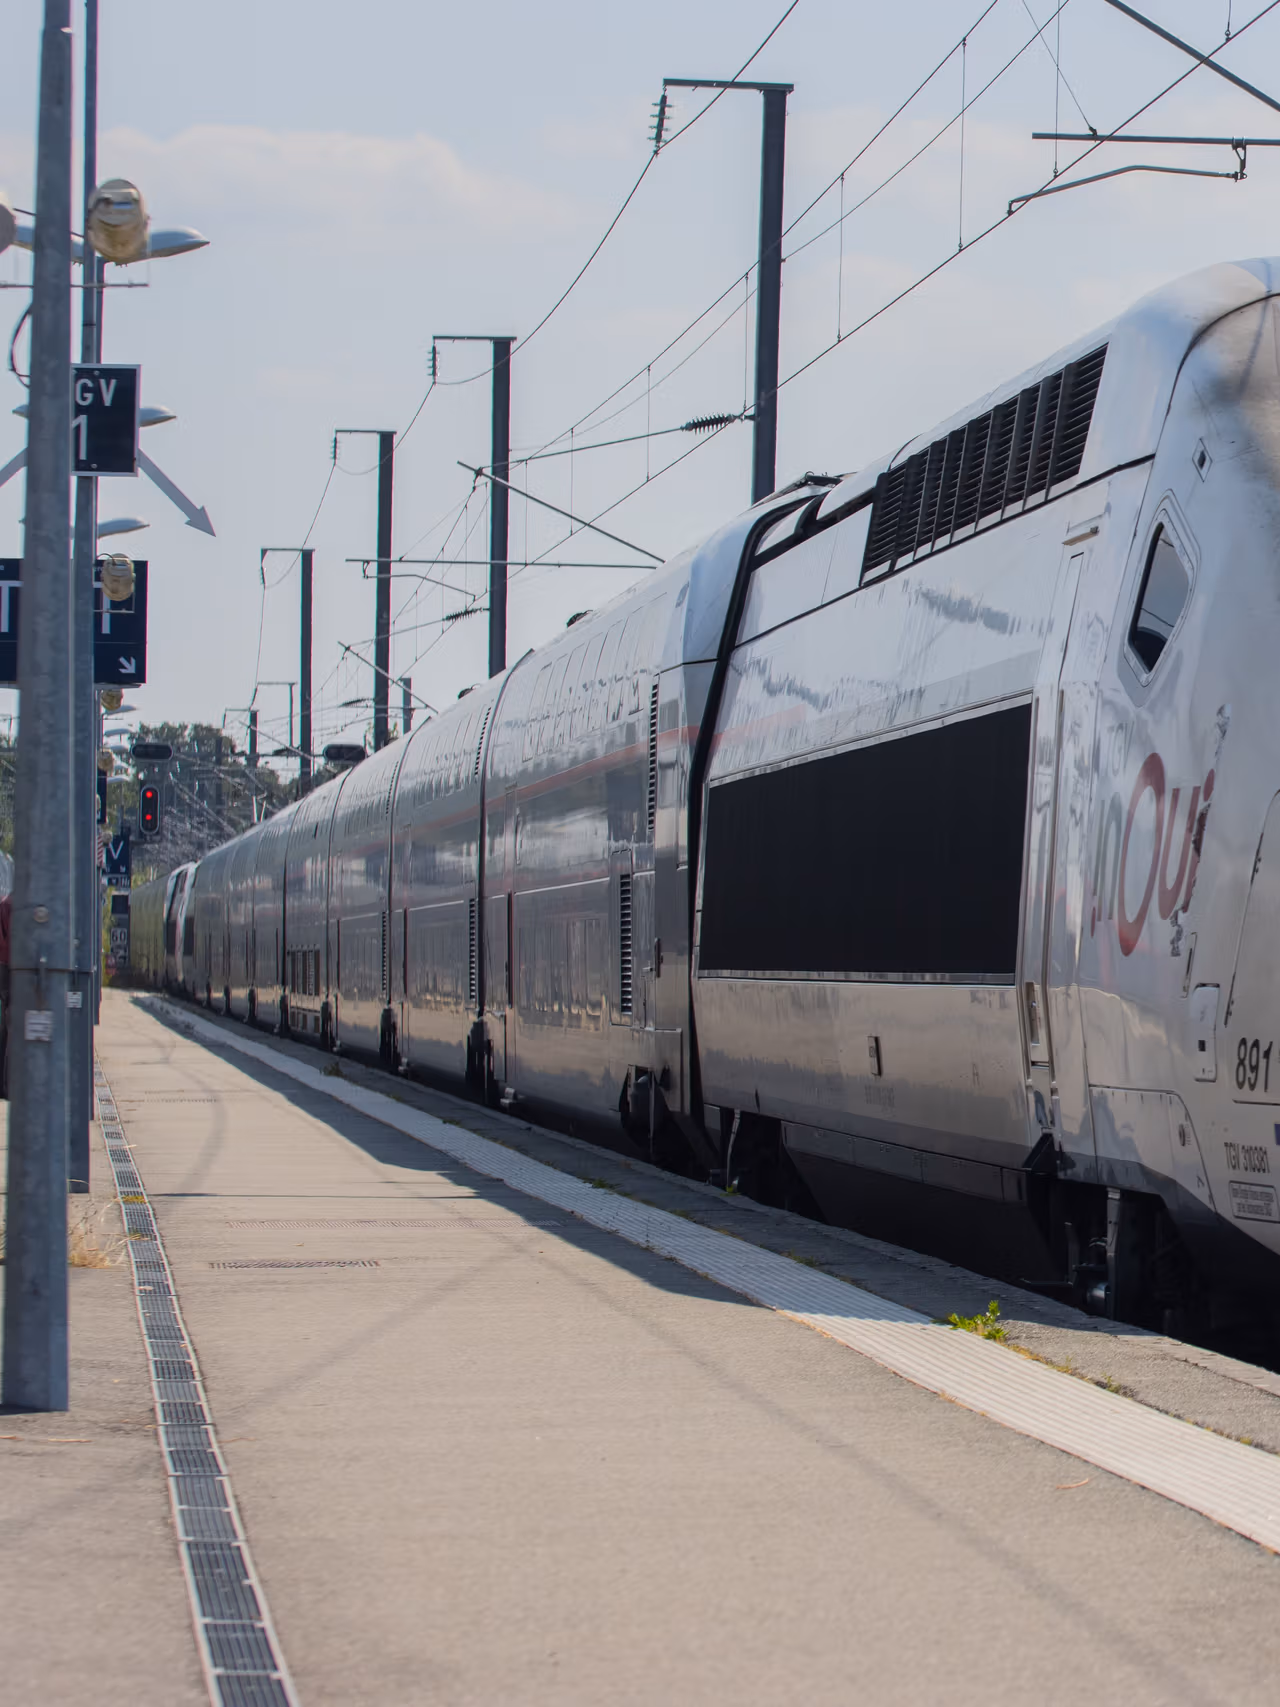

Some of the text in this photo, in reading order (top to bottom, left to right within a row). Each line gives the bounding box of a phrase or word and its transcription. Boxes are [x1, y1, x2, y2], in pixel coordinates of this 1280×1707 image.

[75, 378, 117, 407] GV
[1105, 720, 1135, 777] TGV
[1235, 1037, 1273, 1093] 891
[1223, 1142, 1241, 1171] TGV
